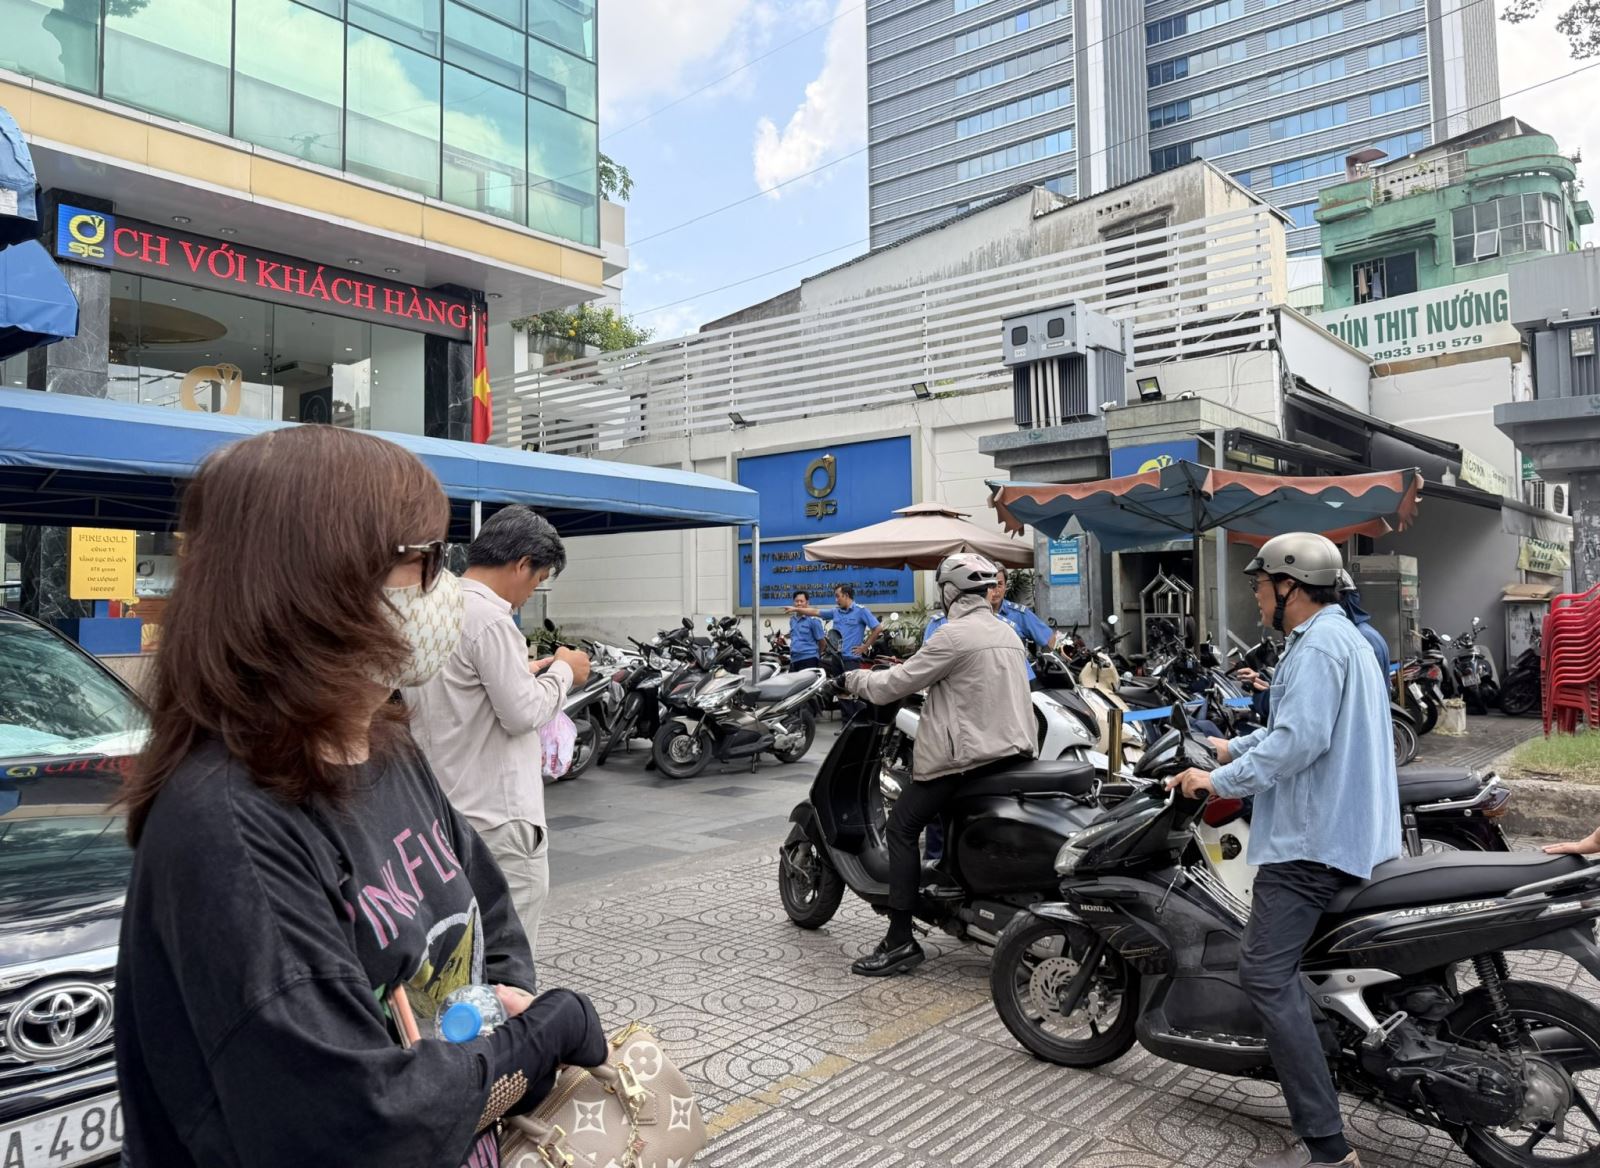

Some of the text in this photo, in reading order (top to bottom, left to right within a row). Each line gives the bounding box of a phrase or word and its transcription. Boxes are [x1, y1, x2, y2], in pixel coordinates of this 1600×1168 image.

[113, 228, 467, 329] CH VỚI KHÁCH HÀNG
[1374, 306, 1419, 345] THỊT
[1426, 289, 1508, 334] NƯỚNG
[1417, 341, 1446, 352] 519
[1452, 335, 1483, 348] 579
[79, 534, 128, 543] FINE GOLD
[1080, 903, 1114, 913] HONDA
